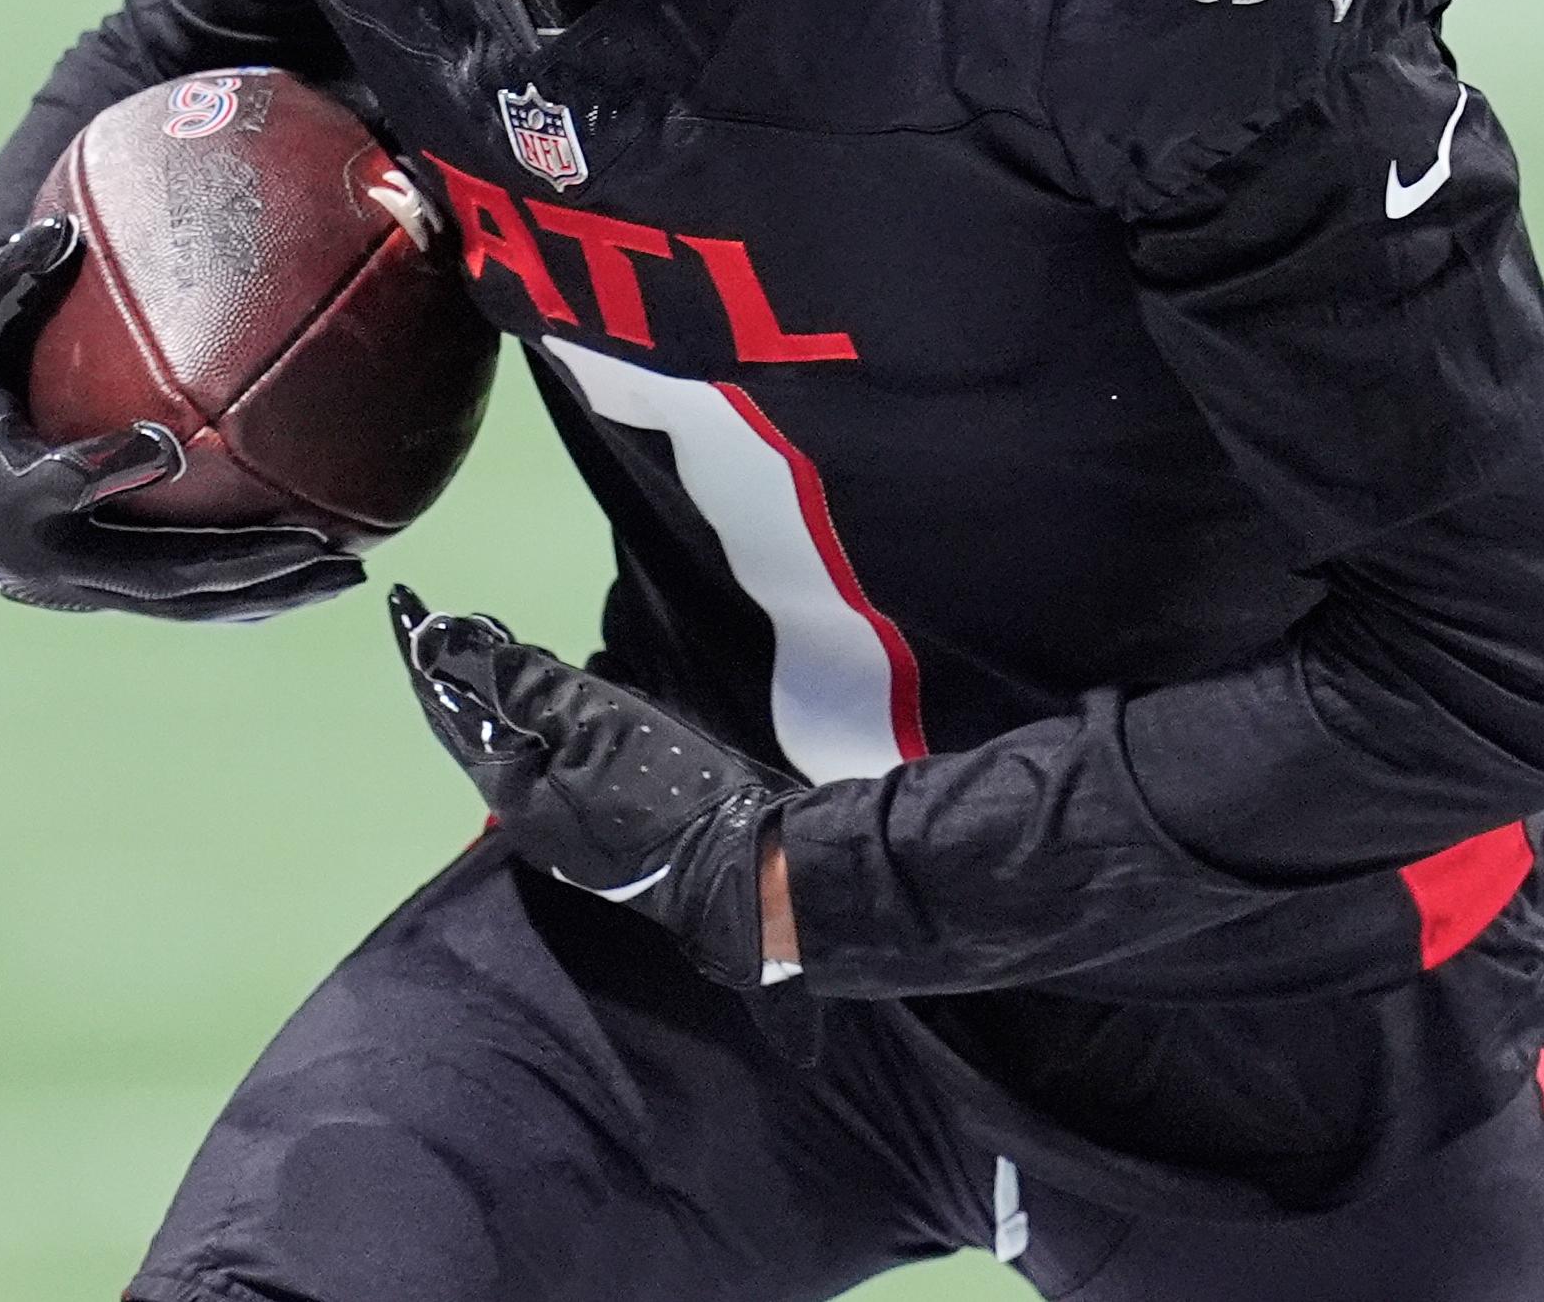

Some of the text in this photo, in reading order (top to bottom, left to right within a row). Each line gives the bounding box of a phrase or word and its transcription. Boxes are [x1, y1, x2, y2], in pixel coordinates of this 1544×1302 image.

[421, 149, 859, 363] ATL
[517, 130, 574, 174] NFL
[541, 334, 930, 787] 1
